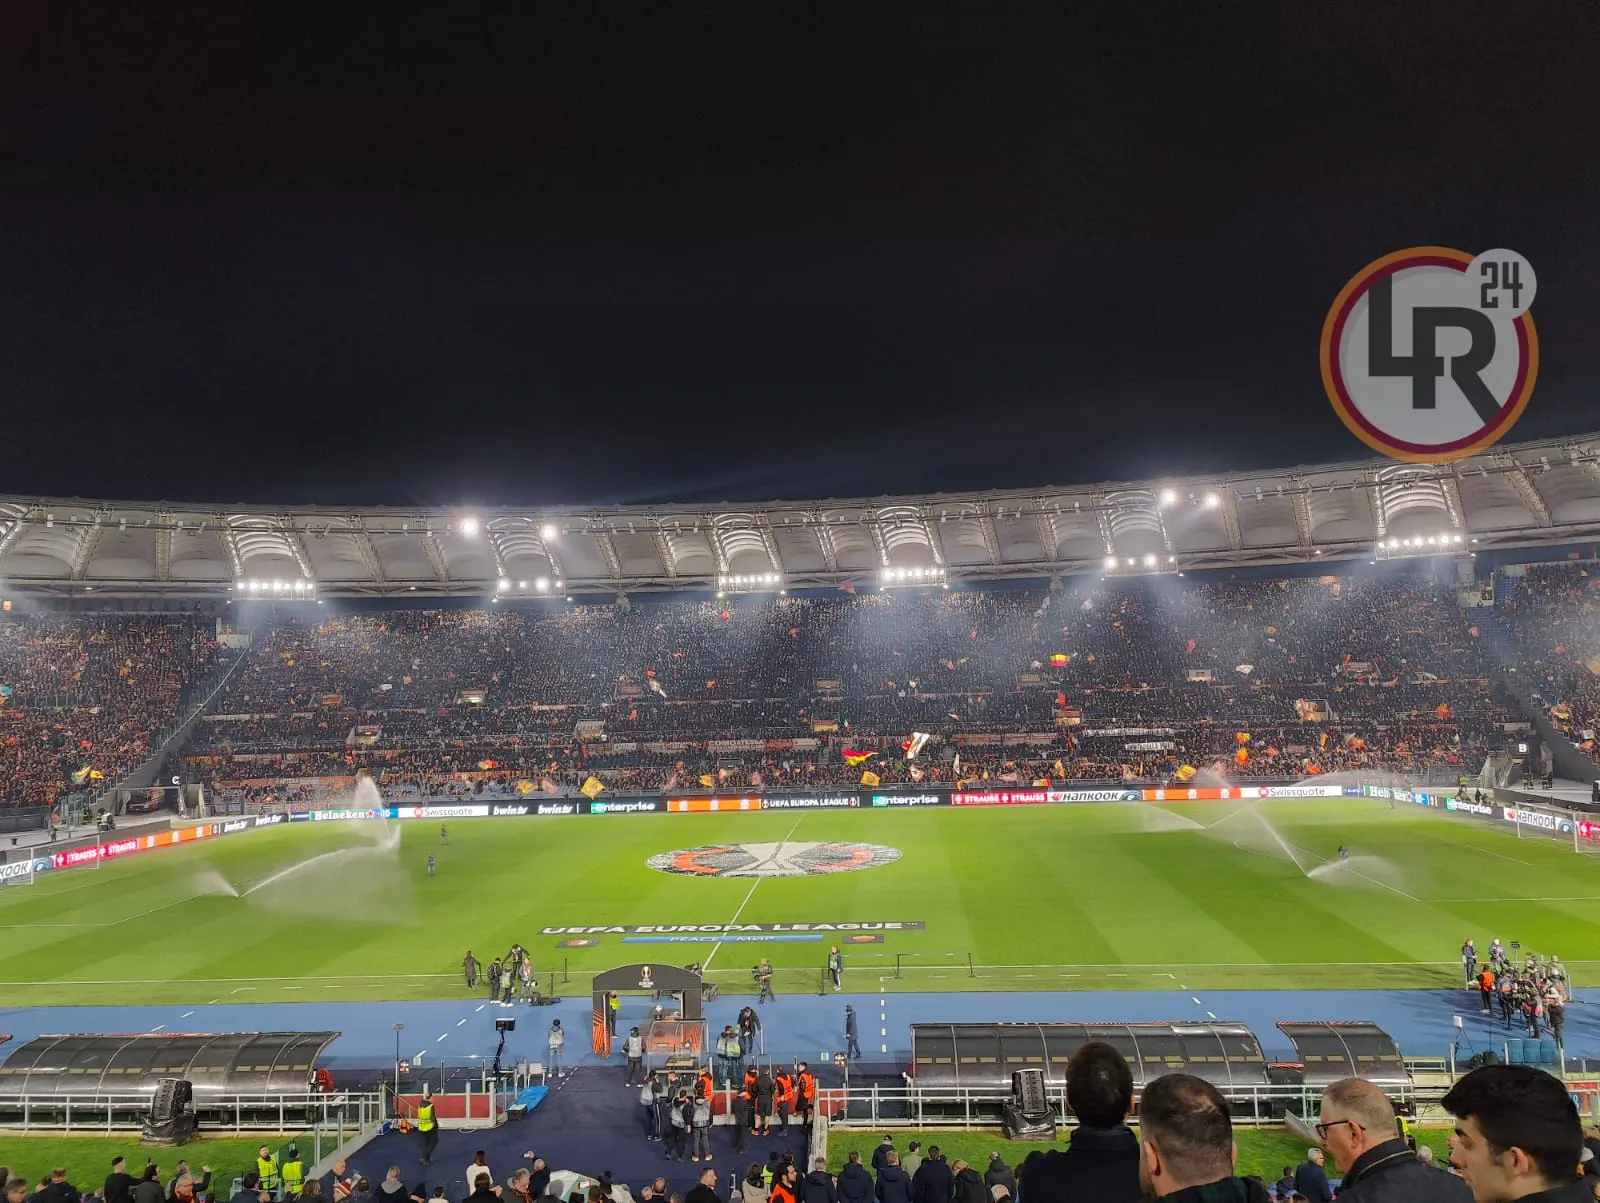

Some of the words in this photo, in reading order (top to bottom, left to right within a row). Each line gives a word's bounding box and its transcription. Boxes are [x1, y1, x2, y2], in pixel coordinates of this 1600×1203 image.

[1518, 743, 1527, 753] B
[171, 775, 181, 785] C
[1270, 787, 1325, 797] Swissquote
[820, 798, 849, 806] LEAGUE
[877, 795, 939, 806] enterprise
[596, 801, 655, 811] enterprise
[1449, 799, 1492, 814] enterprise
[315, 810, 365, 820] Heineken
[425, 807, 473, 816] Swissquote
[635, 925, 763, 933] EUROPA
[773, 922, 902, 931] LEAGUE
